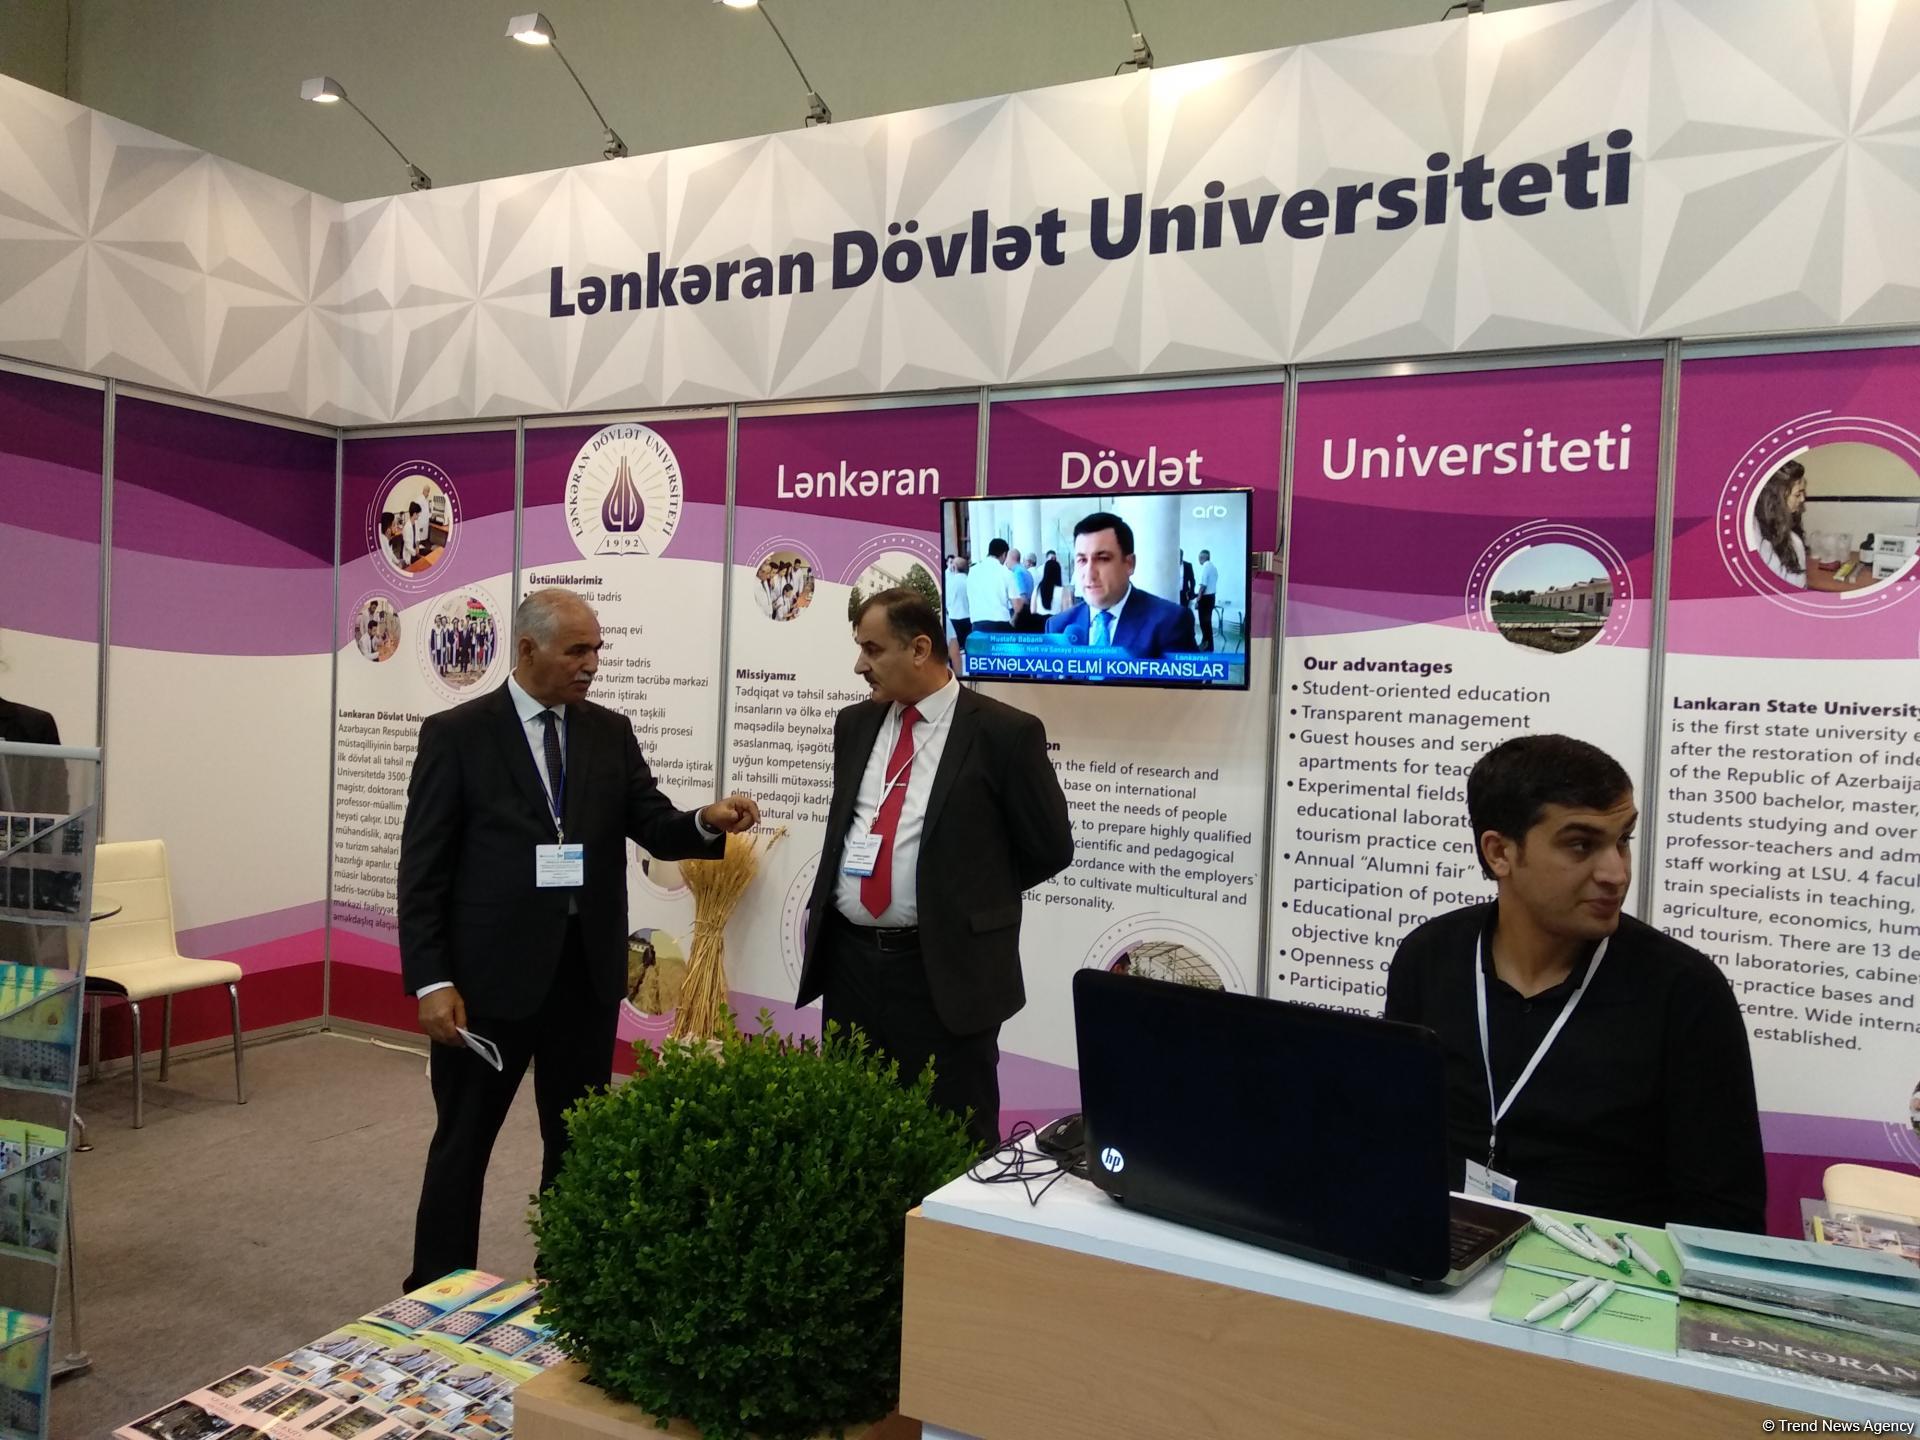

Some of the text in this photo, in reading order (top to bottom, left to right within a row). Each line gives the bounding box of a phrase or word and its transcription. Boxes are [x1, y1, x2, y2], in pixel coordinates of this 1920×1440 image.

[550, 128, 1633, 317] Lənkəran Dövlət Universiteti
[592, 428, 642, 452] DÖVLƏT
[777, 423, 1632, 499] Lənkəran Dövlət Universiteti
[530, 574, 602, 585] Üstünlüklərimiz
[598, 592, 622, 602] tədris
[630, 624, 643, 634] evi
[626, 658, 651, 667] tədris
[969, 656, 1224, 678] BEYNƏLXALQ ELMİ KONFRANSLAR
[1304, 656, 1453, 677] Our advantages
[606, 675, 633, 684] turizm
[637, 676, 670, 685] təcrübə
[736, 669, 796, 682] Missiyamız
[736, 686, 823, 700] Tədqiqat və təhsil
[1302, 680, 1550, 702] Student-oriented education
[735, 705, 821, 717] insanların və ölkə
[1673, 696, 1760, 712] Lankaran
[1767, 700, 1817, 714] State
[734, 722, 784, 733] məqsədilə
[1302, 705, 1530, 729] Transparent management
[634, 724, 693, 736] tədris prosesi
[1300, 730, 1454, 750] Guest houses and
[1672, 719, 1907, 745] is the first state university
[1670, 742, 1878, 764] after the restoration of
[686, 760, 712, 772] iştirak
[1066, 760, 1219, 781] the field of research and
[1299, 755, 1429, 774] apartments for
[1669, 765, 1830, 785] of the Republic of
[732, 772, 778, 784] ali təhsilli
[1064, 779, 1196, 799] base on international
[1298, 778, 1411, 798] Experimental
[1100, 802, 1120, 813] the
[1124, 804, 1161, 816] needs
[1165, 806, 1178, 817] of
[1182, 809, 1227, 822] people
[1296, 803, 1397, 823] educational
[1669, 788, 1920, 817] than 3500 bachelor, master,
[1082, 820, 1251, 845] to prepare highly qualified
[1667, 812, 1917, 839] students studying and over
[1296, 828, 1437, 850] tourism practice
[1666, 834, 1873, 860] professor-teachers and
[1126, 842, 1234, 864] and pedagogical
[1294, 850, 1354, 868] Annual
[1129, 860, 1155, 875] with
[1160, 864, 1180, 878] the
[1665, 857, 1869, 883] staff working at LSU. 4
[1064, 875, 1247, 905] to cultivate multicultural and
[1293, 876, 1427, 901] participation of
[1664, 879, 1915, 915] train specialists in teaching,
[1046, 892, 1115, 912] personality.
[1293, 899, 1392, 922] Educational
[1663, 902, 1871, 934] agriculture, economics,
[1292, 924, 1369, 946] objective
[1700, 928, 1773, 946] tourism.
[1780, 934, 1831, 951] There
[1837, 943, 1866, 955] are
[1873, 943, 1890, 957] 13
[1291, 948, 1374, 970] Openness
[1735, 953, 1849, 979] laboratories,
[1290, 972, 1386, 997] Participatio
[1821, 985, 1914, 1008] bases and
[1805, 1007, 1852, 1026] Wide
[1753, 1027, 1861, 1050] established.
